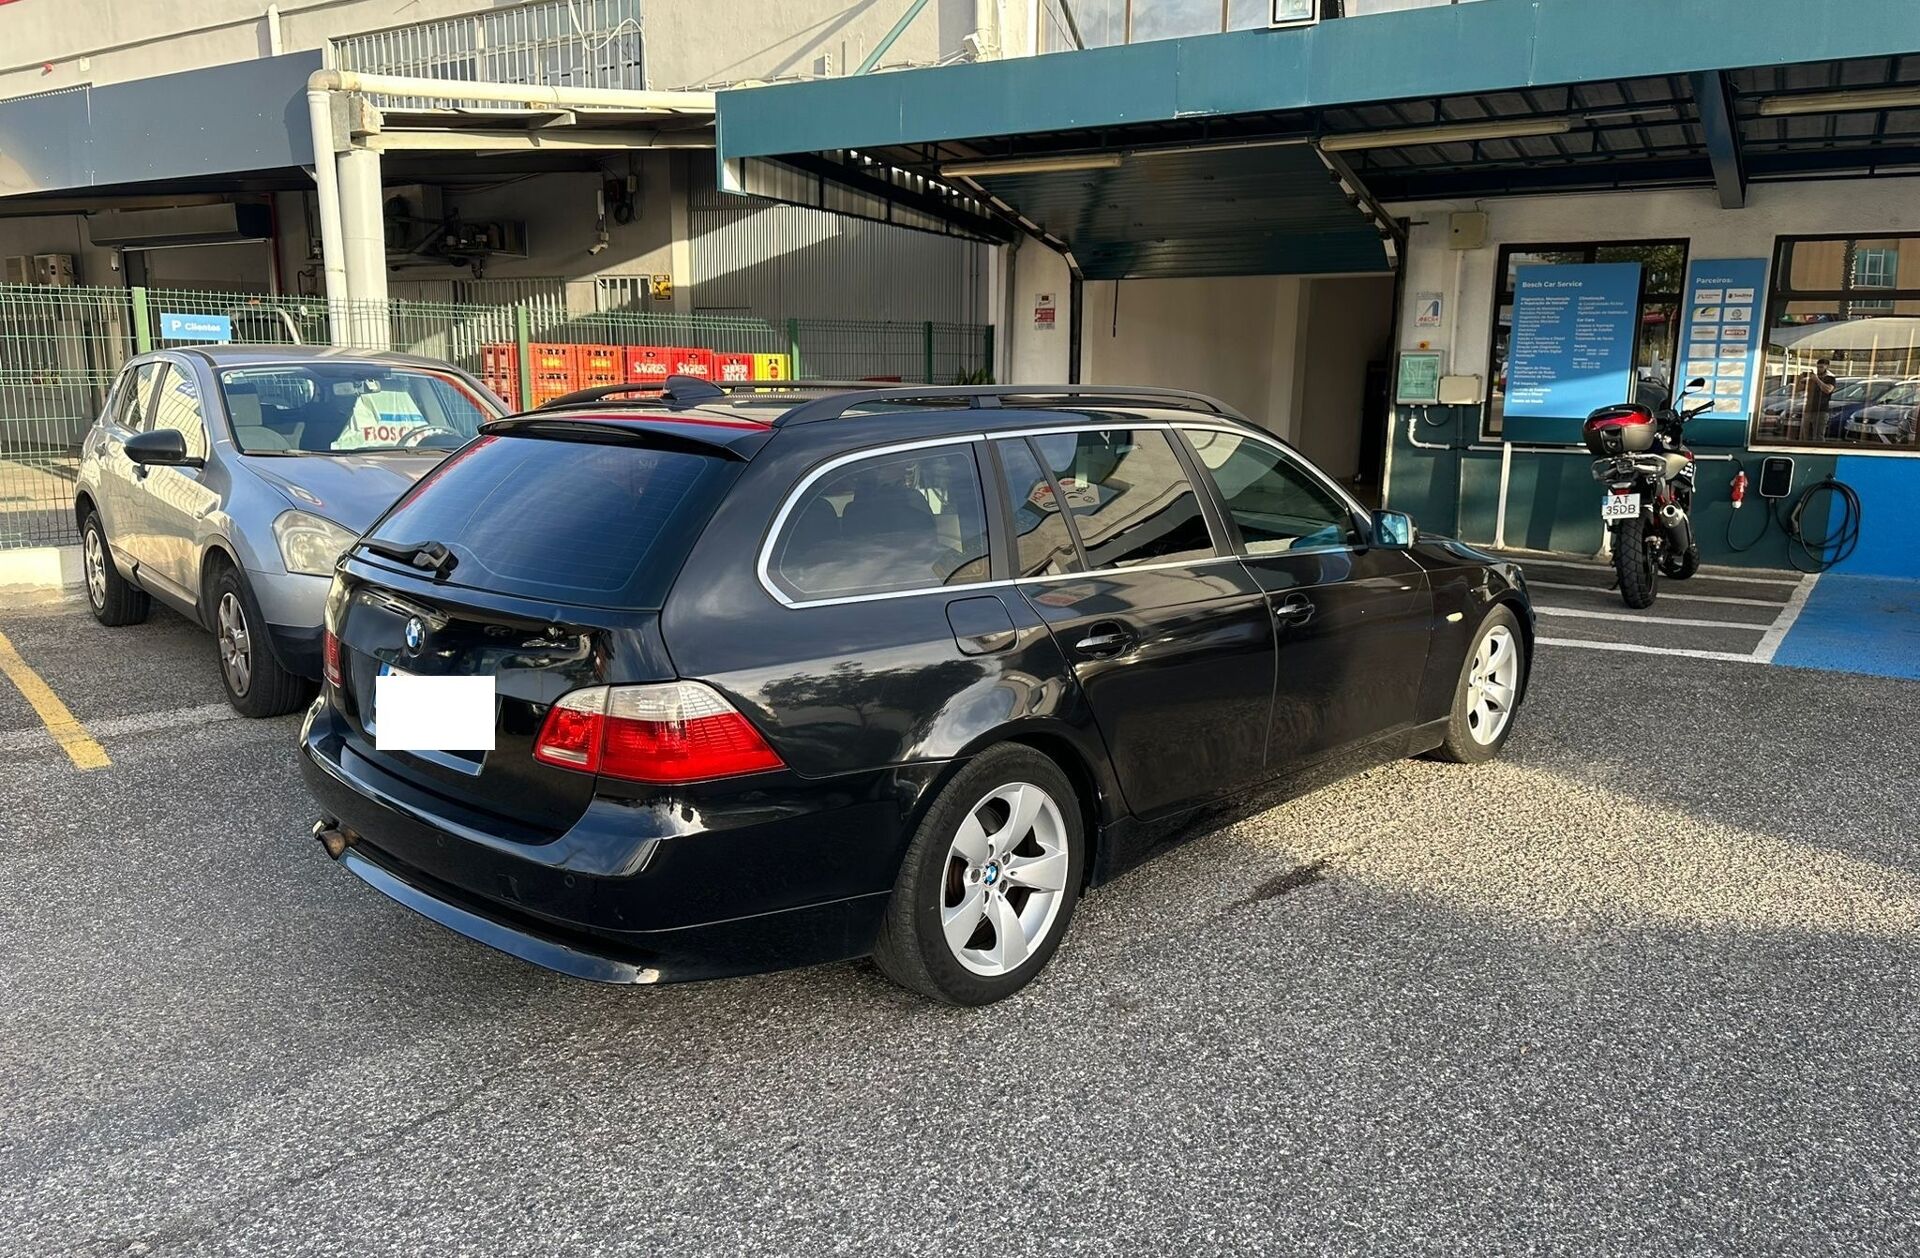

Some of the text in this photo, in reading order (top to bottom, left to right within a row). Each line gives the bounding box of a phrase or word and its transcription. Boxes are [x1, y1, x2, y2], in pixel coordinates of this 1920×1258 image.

[1557, 280, 1583, 288] Service
[171, 320, 221, 331] P Clientes
[633, 361, 667, 374] SAGRES
[676, 362, 708, 375] SAGRES
[1614, 495, 1629, 504] AT
[1606, 504, 1636, 515] 35DB
